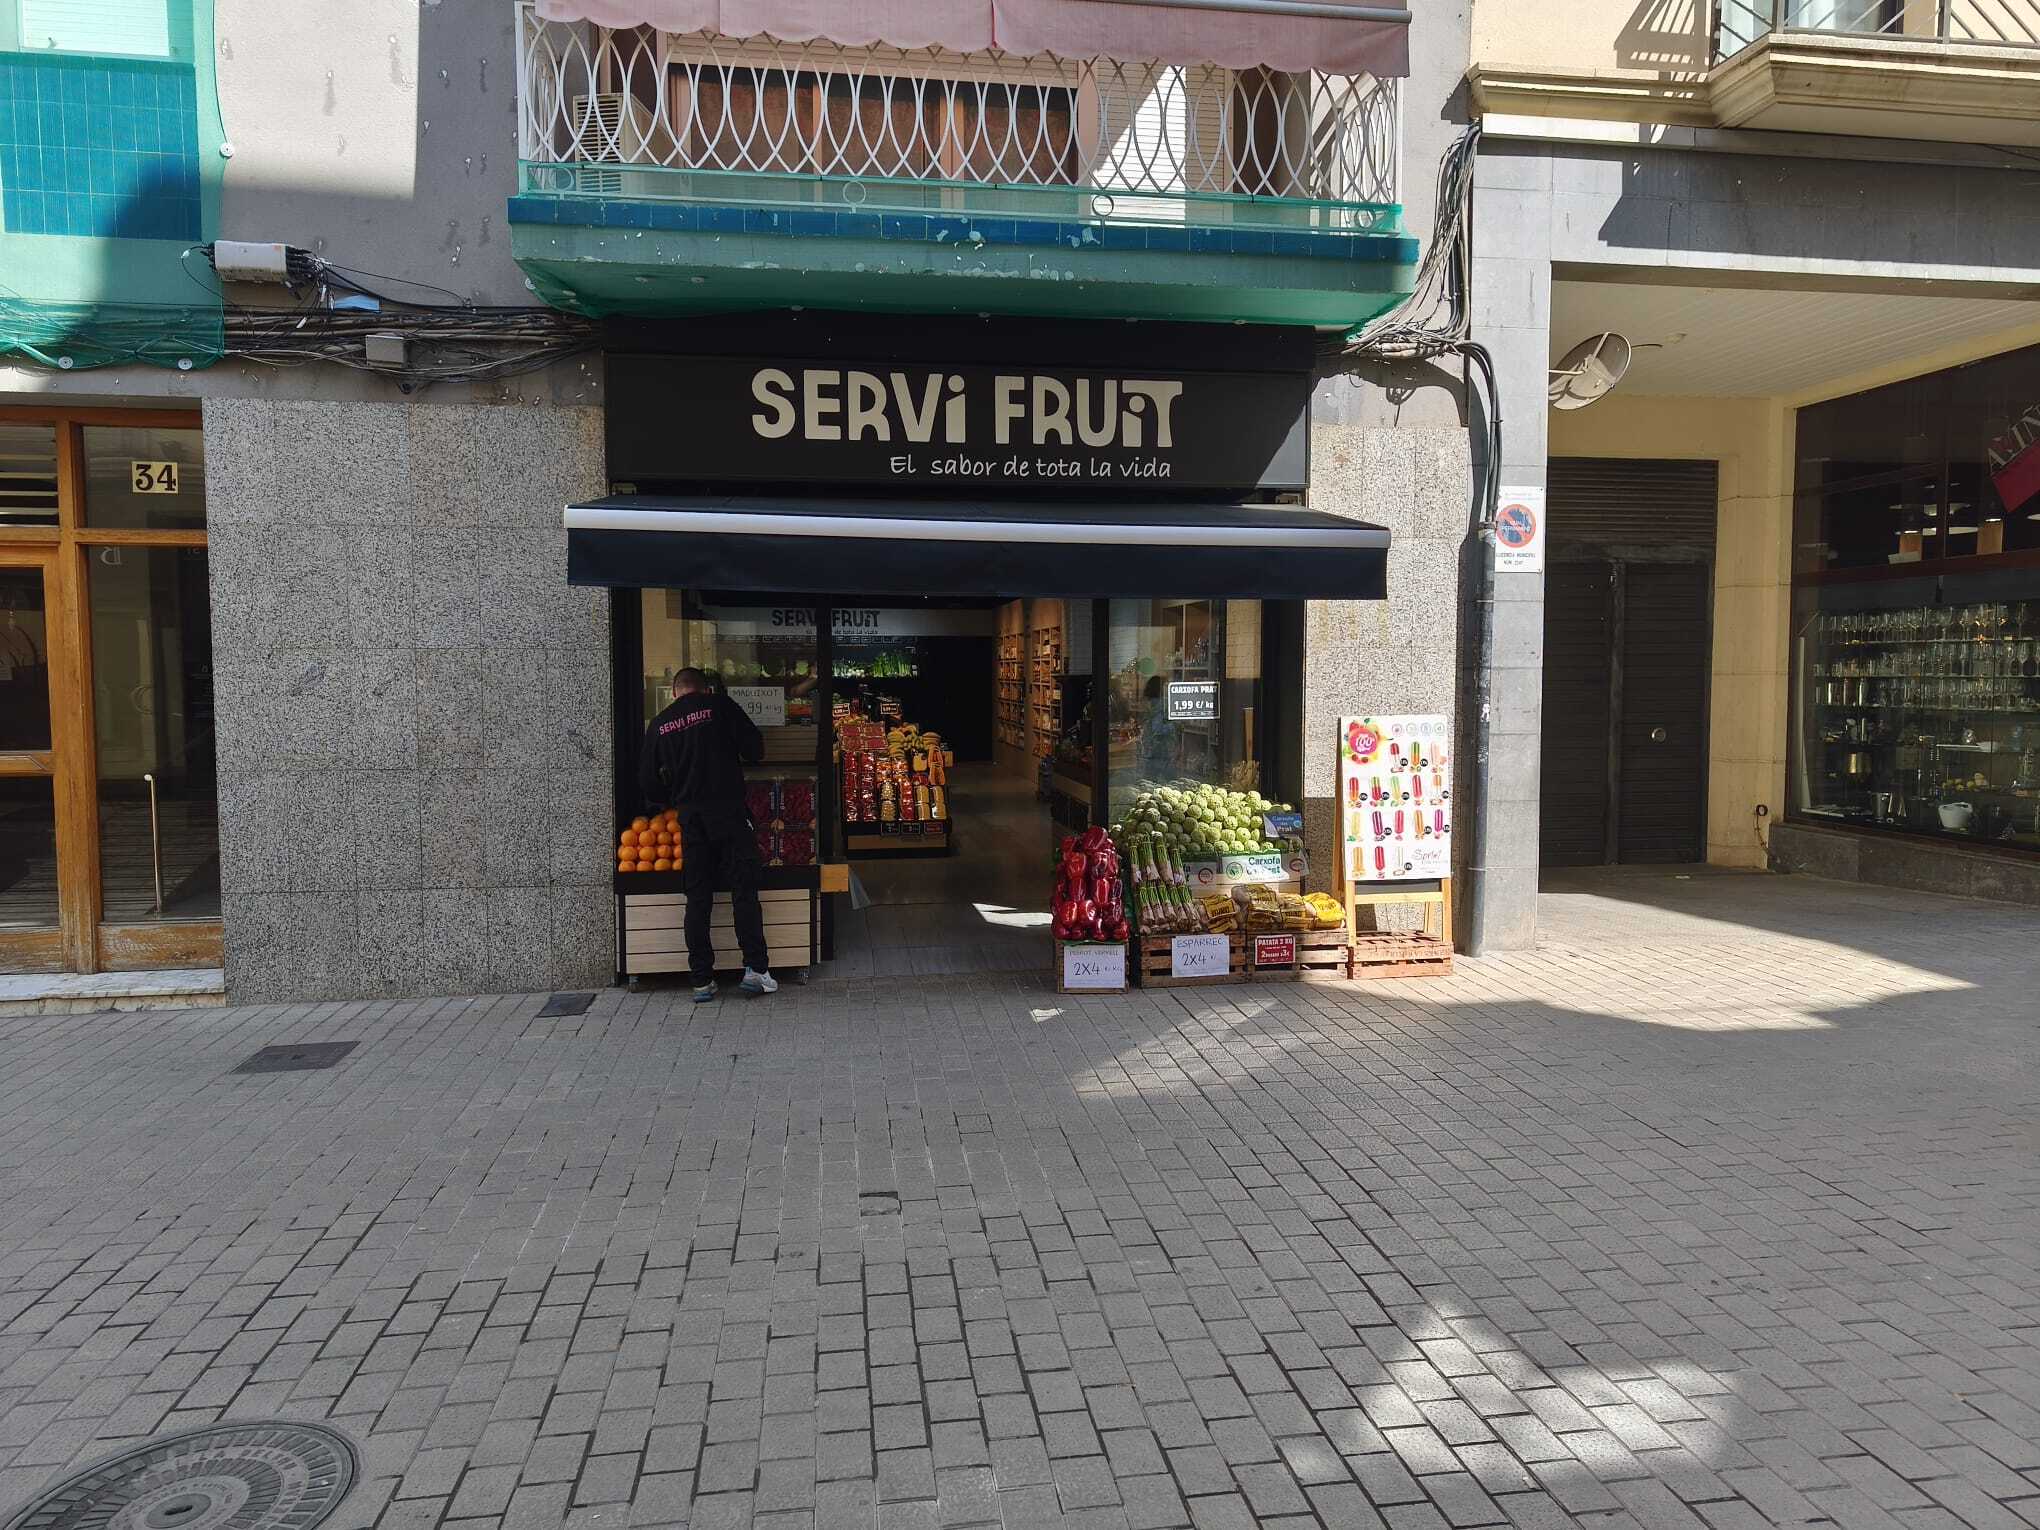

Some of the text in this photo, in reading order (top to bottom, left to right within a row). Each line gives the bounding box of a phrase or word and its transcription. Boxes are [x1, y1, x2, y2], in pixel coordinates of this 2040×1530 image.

[135, 464, 176, 491] 34
[889, 455, 1171, 478] El sabor de tota la vida
[1248, 855, 1281, 866] Carxofa
